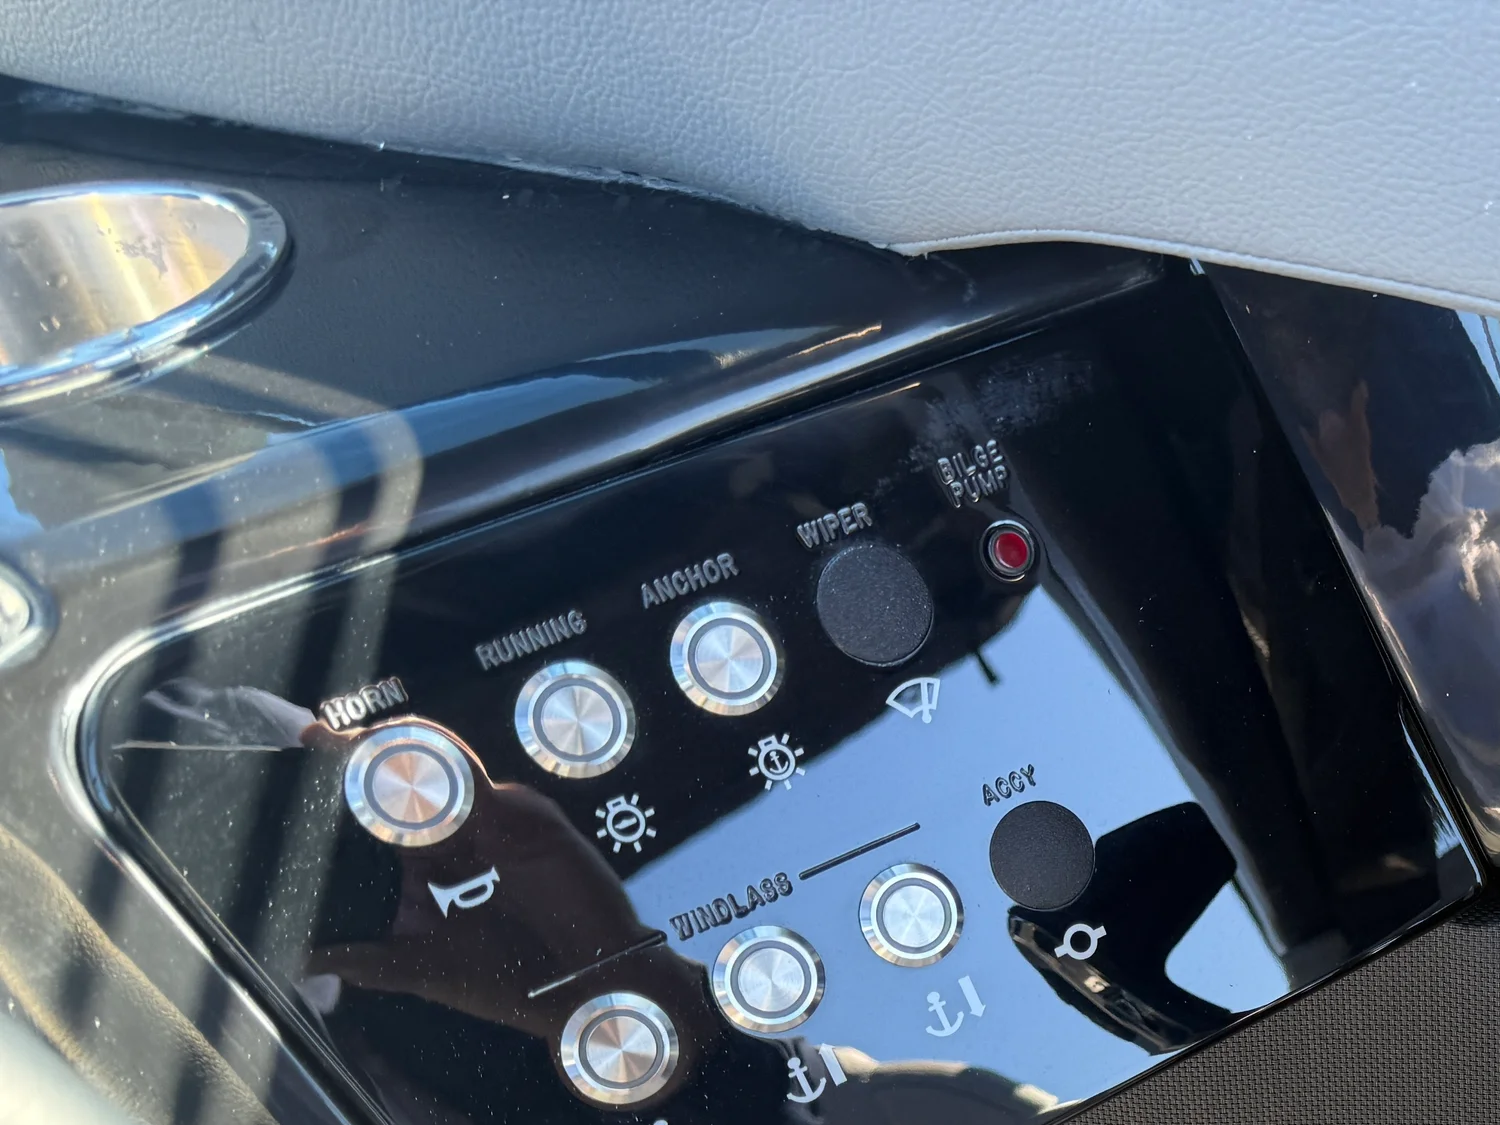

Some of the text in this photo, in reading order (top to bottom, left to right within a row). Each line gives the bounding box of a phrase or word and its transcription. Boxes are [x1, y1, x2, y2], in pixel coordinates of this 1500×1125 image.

[936, 438, 1004, 486] BILGE
[949, 464, 1009, 508] PUMP
[796, 502, 873, 549] WIPER
[640, 552, 741, 610] ANCHOR
[475, 609, 588, 671] RUNNING
[319, 676, 409, 731] HORN
[982, 763, 1038, 807] ACCY
[669, 872, 795, 941] WINDLASS
